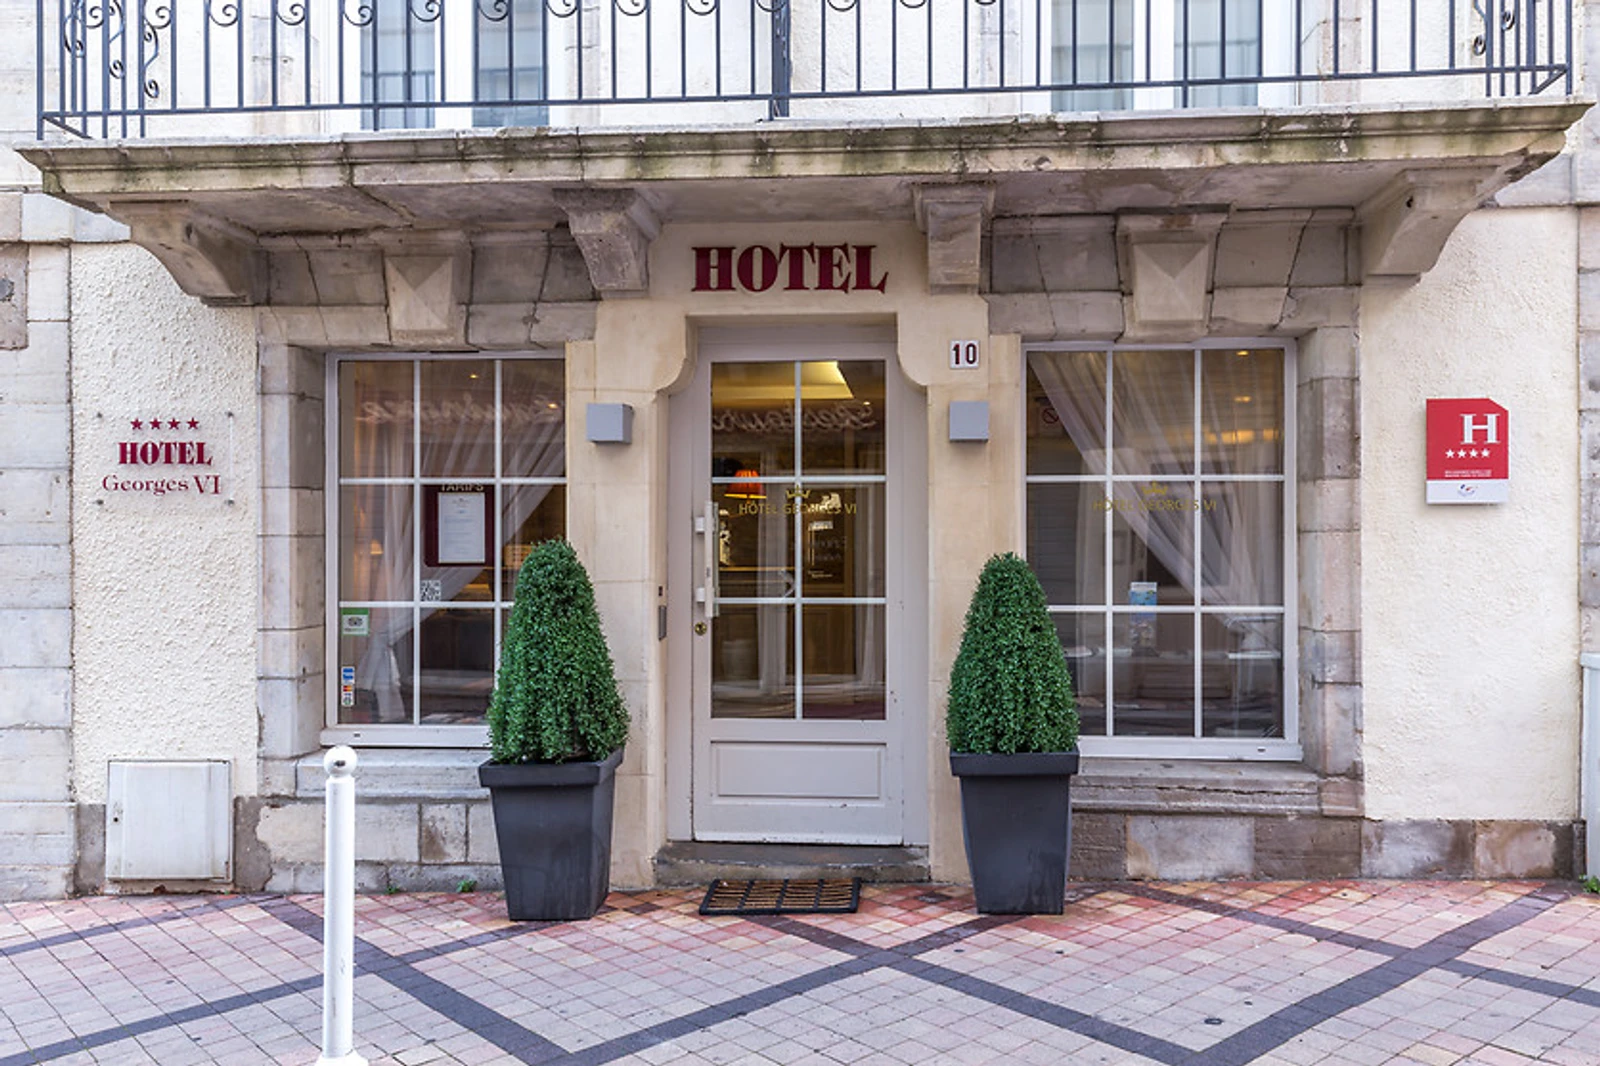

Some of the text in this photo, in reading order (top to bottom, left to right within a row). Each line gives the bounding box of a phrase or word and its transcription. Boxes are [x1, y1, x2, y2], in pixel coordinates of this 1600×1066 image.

[691, 242, 889, 294] HOTEL
[952, 343, 977, 365] 10
[1460, 413, 1501, 445] H
[117, 441, 213, 466] HOTEL
[102, 474, 222, 496] Georges VI
